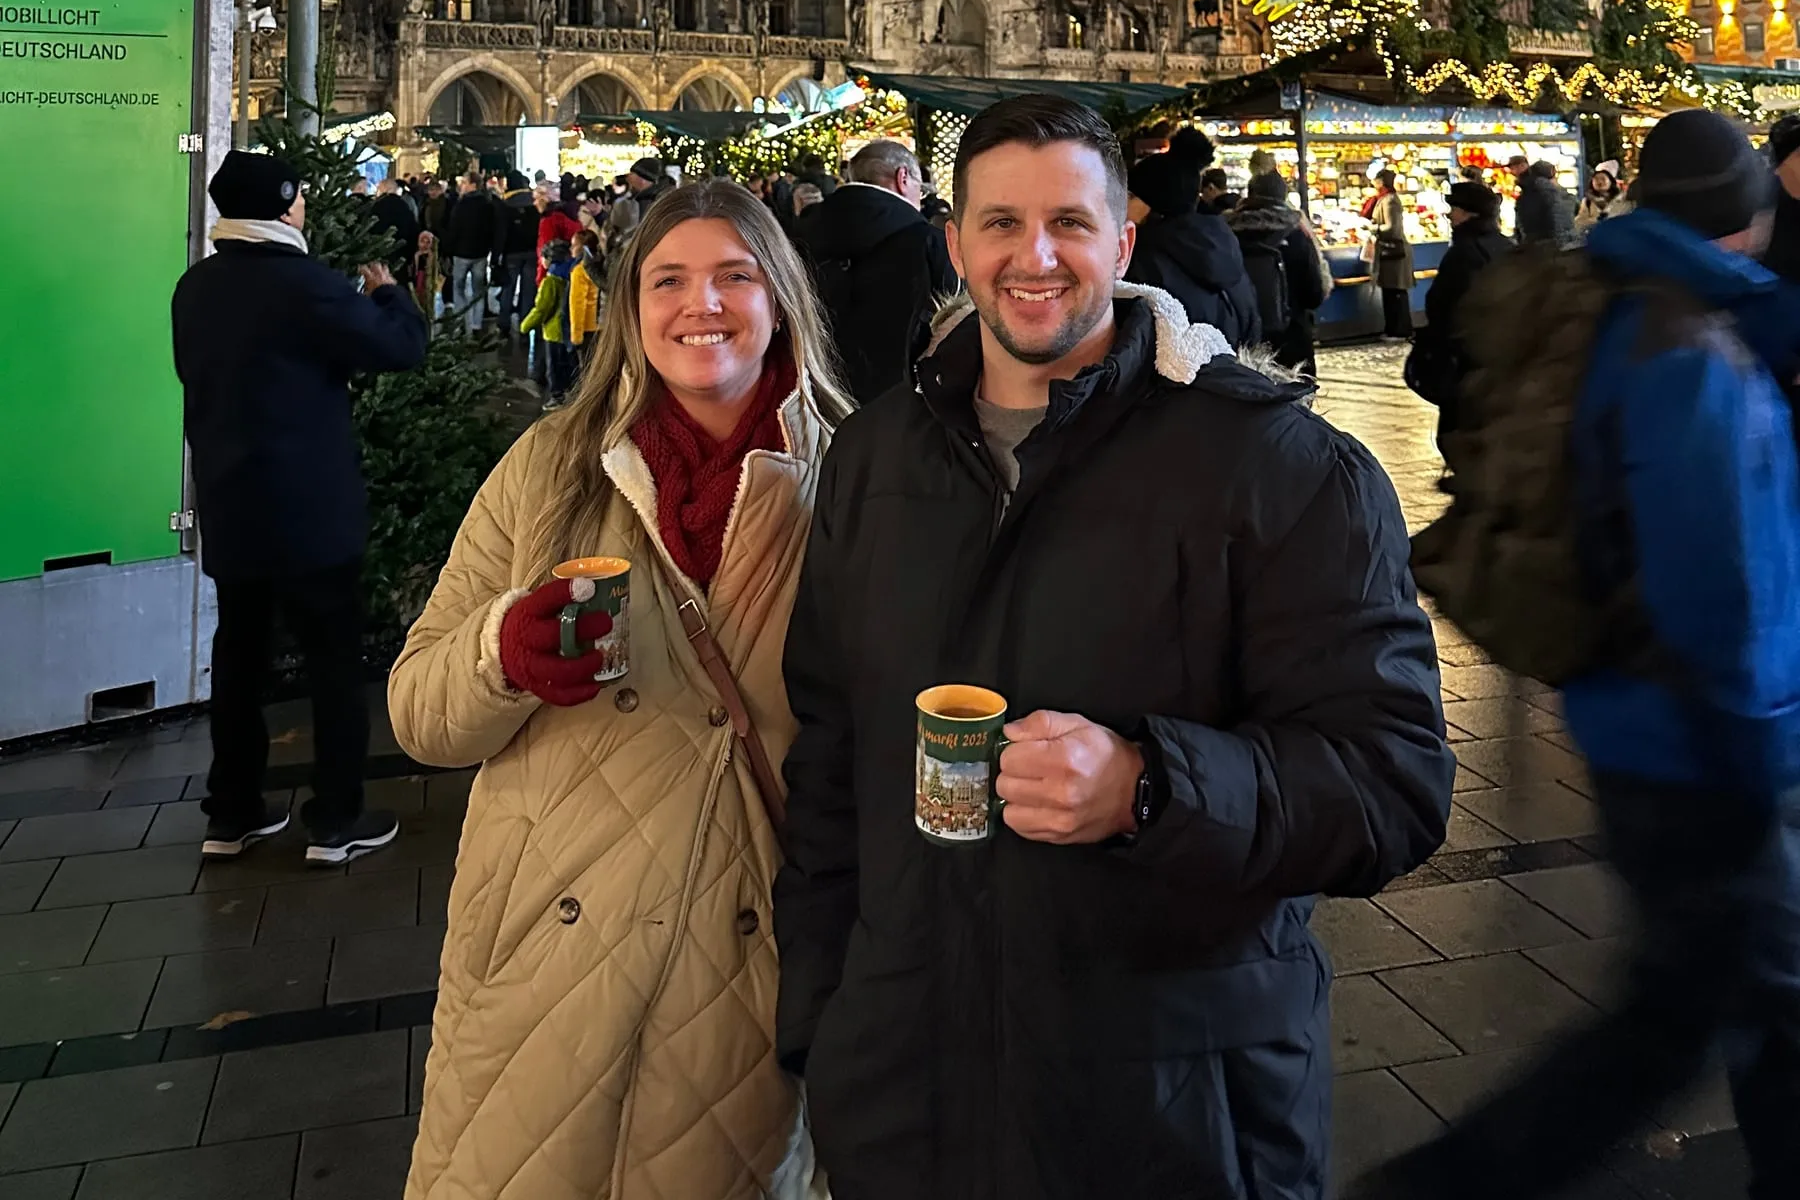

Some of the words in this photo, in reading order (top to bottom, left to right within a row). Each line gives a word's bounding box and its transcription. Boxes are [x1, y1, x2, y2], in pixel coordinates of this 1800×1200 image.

[0, 7, 100, 26] OBILLICHT
[0, 41, 126, 60] EUTSCHLAND
[0, 91, 159, 105] ICHT-DEUTSCHLAND.DE
[920, 726, 959, 750] markt
[963, 732, 988, 747] 2025
